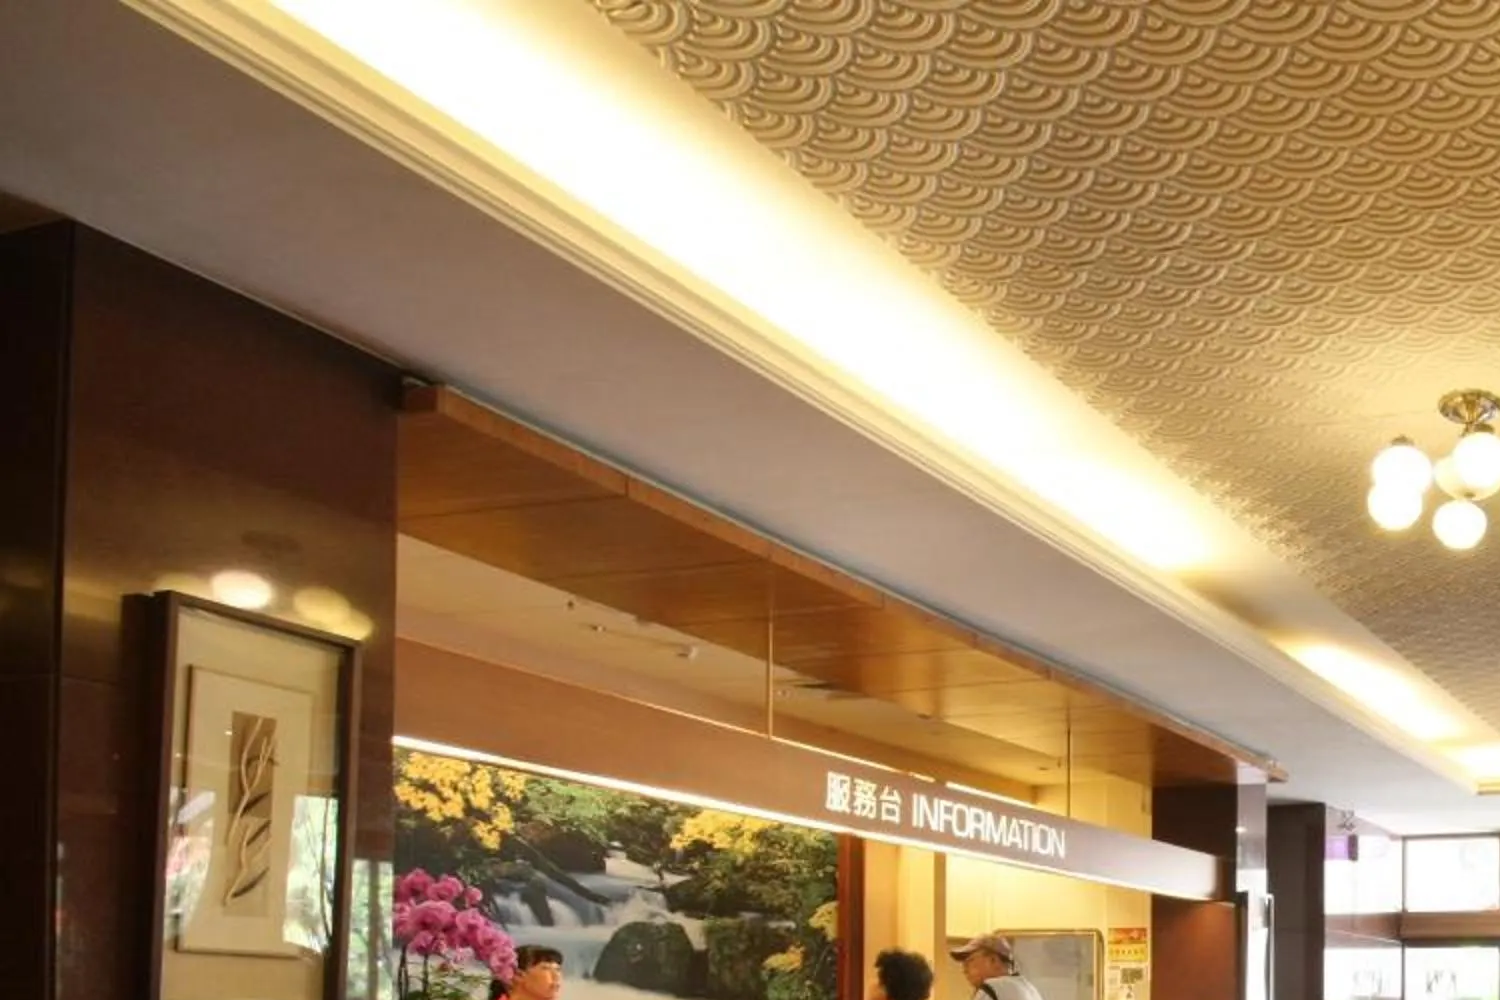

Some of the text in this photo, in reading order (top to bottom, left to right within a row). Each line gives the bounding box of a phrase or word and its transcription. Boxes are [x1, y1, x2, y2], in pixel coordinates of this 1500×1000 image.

[825, 771, 1065, 858] 服務台 INFORMATION
